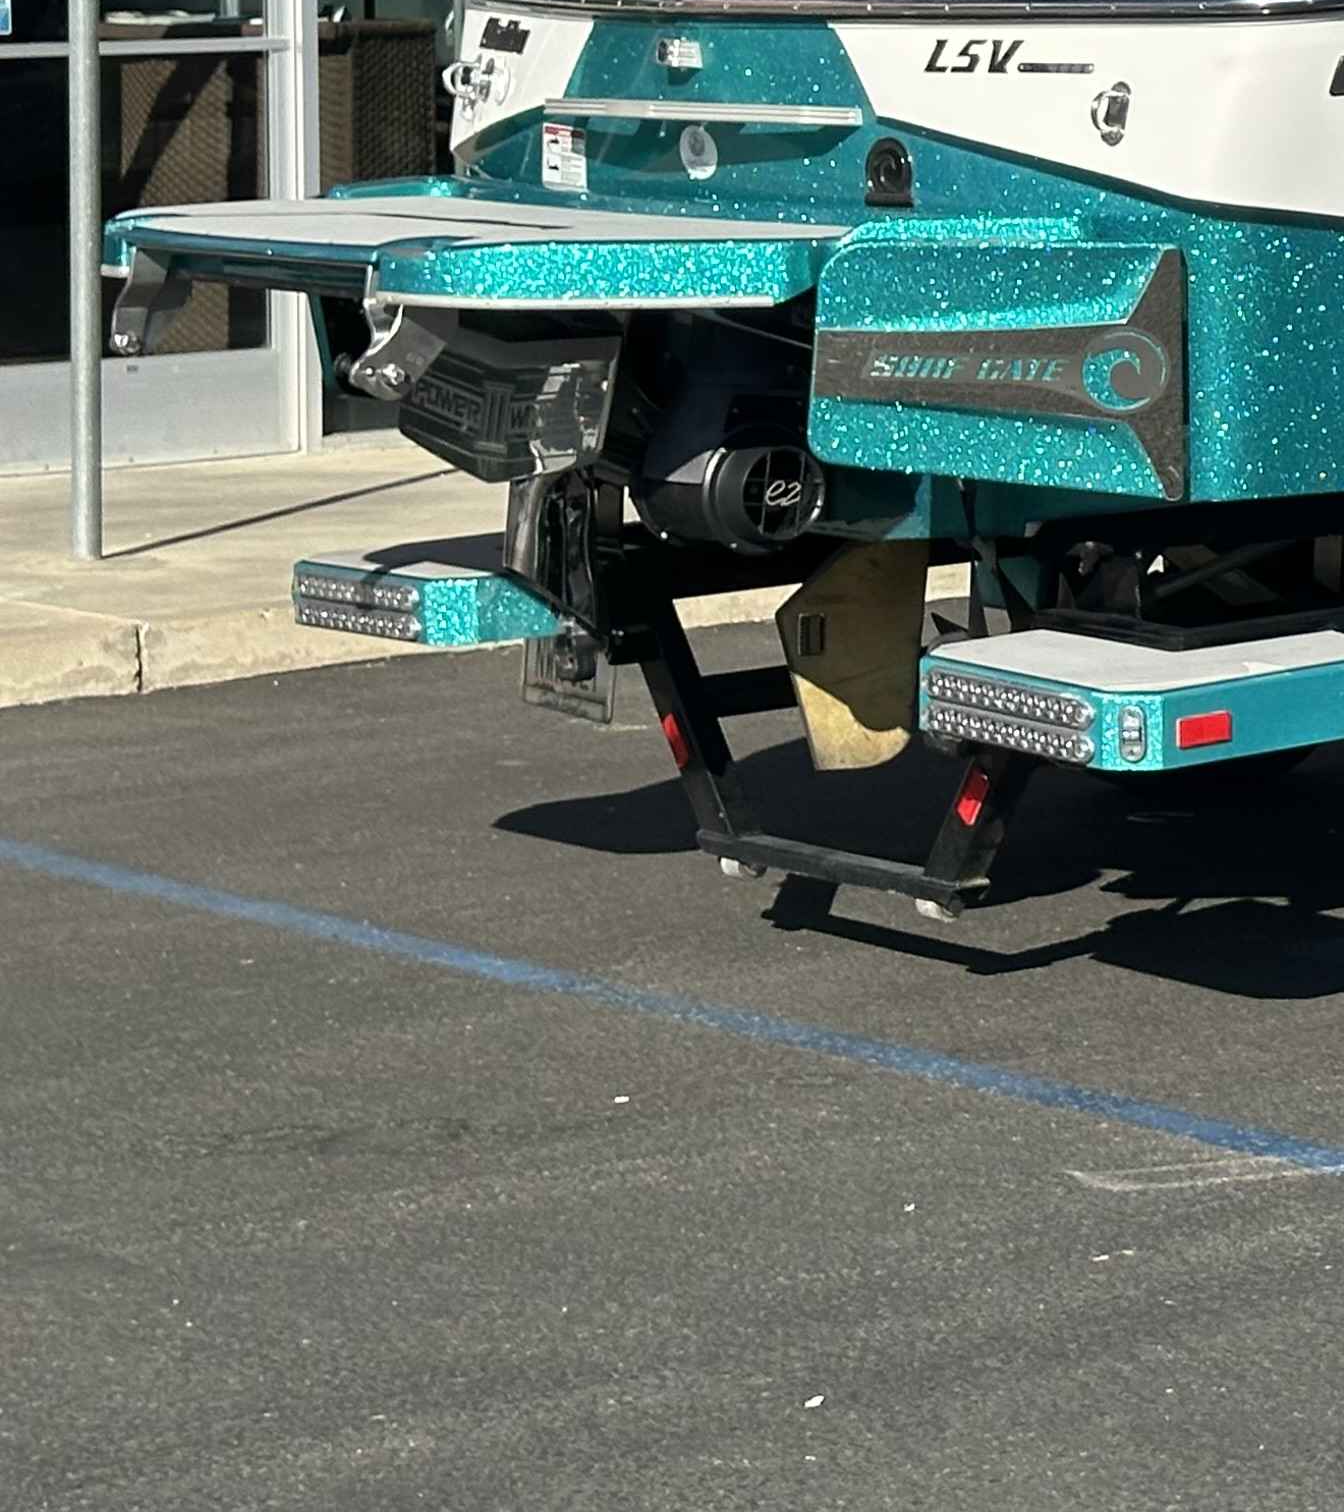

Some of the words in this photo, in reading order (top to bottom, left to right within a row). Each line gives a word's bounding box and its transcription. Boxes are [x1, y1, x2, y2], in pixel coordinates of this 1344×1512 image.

[925, 39, 1024, 74] LSV
[869, 354, 967, 379] SURF
[975, 358, 1068, 381] GATE
